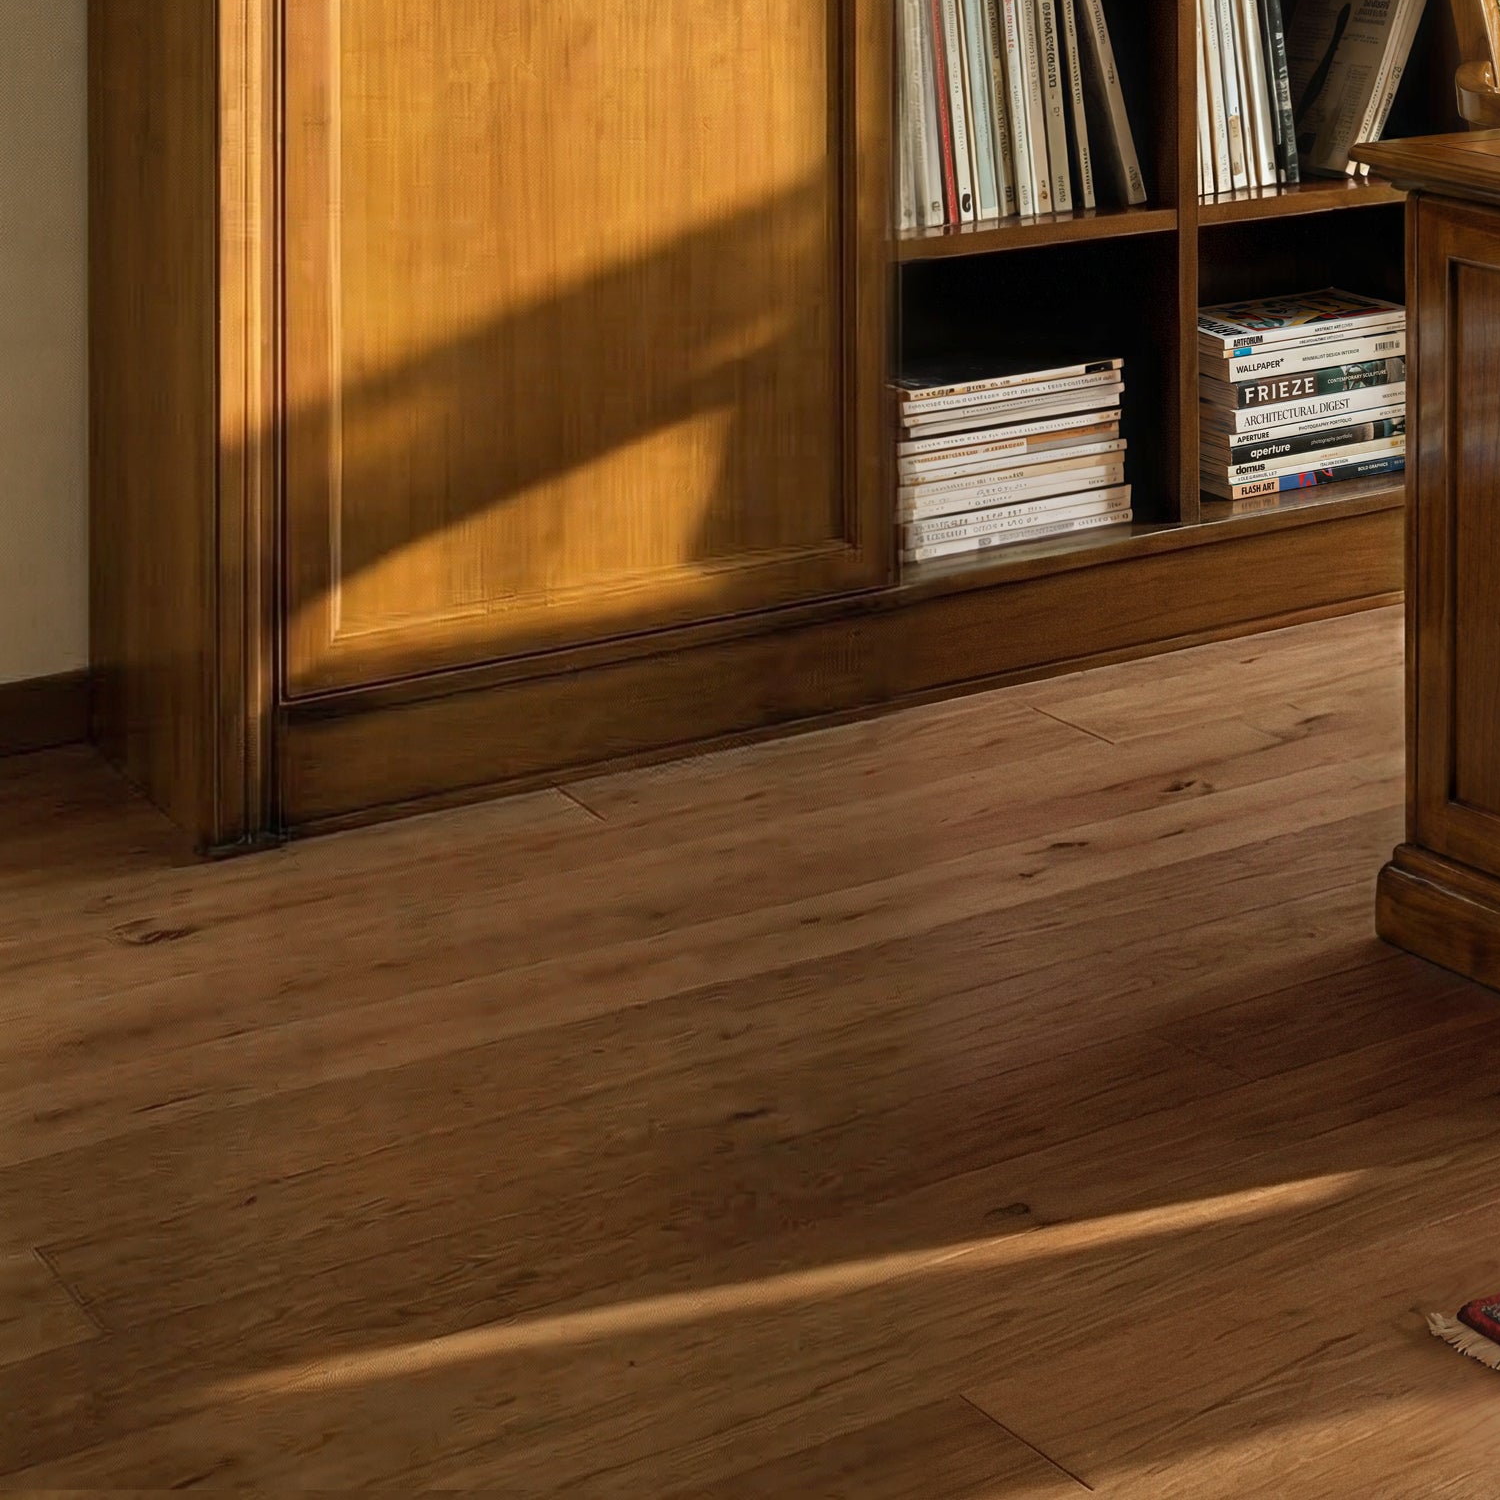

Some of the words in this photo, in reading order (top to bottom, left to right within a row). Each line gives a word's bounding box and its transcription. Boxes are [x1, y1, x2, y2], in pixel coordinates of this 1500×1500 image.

[1233, 335, 1263, 347] ARTFORUM
[1244, 377, 1315, 404] FRIEZE
[1244, 404, 1318, 427] ARCHITECTURAL
[1319, 398, 1350, 413] DIGEST
[1237, 431, 1270, 443] APERTURE
[1250, 444, 1291, 459] aperture
[1236, 463, 1265, 475] domus
[1241, 485, 1261, 496] FLASH
[1262, 482, 1275, 491] ART
